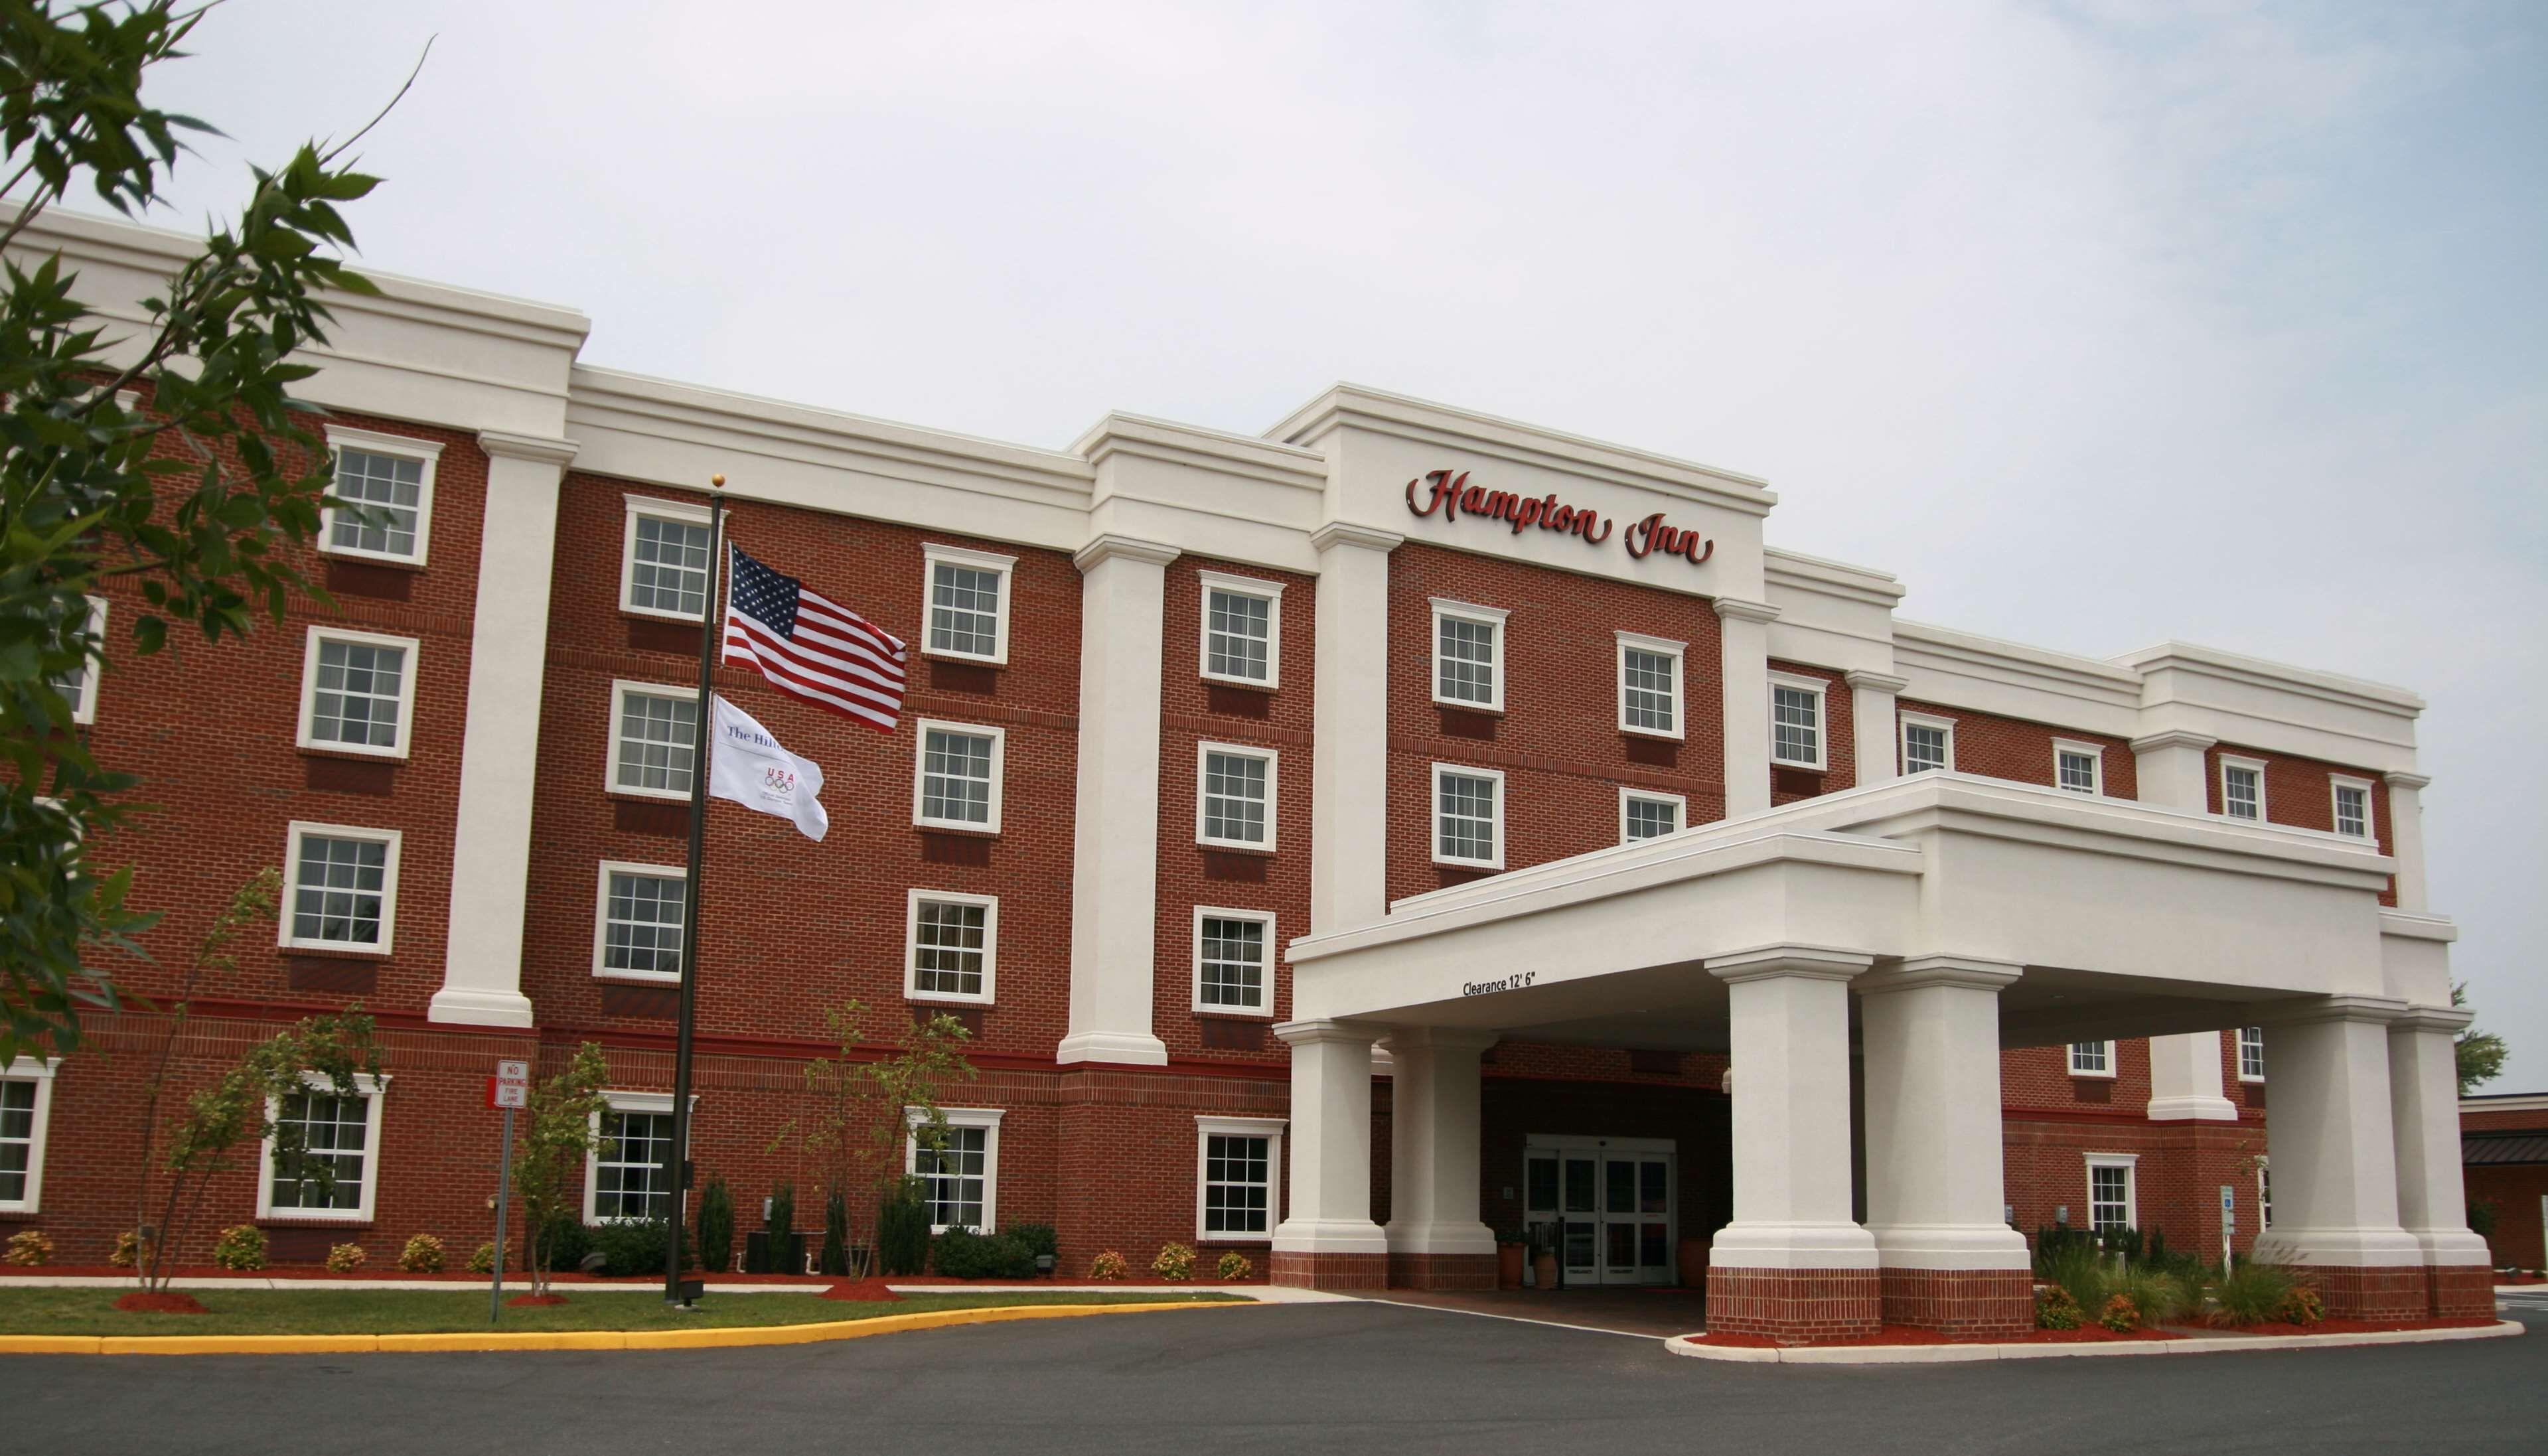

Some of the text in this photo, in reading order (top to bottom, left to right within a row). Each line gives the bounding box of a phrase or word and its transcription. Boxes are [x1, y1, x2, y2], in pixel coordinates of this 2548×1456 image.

[1406, 470, 1714, 563] Hampton Inn
[727, 725, 751, 741] The
[1463, 971, 1536, 995] Clearance 12' 6"
[506, 1066, 519, 1075] NO
[498, 1078, 526, 1086] PARKING
